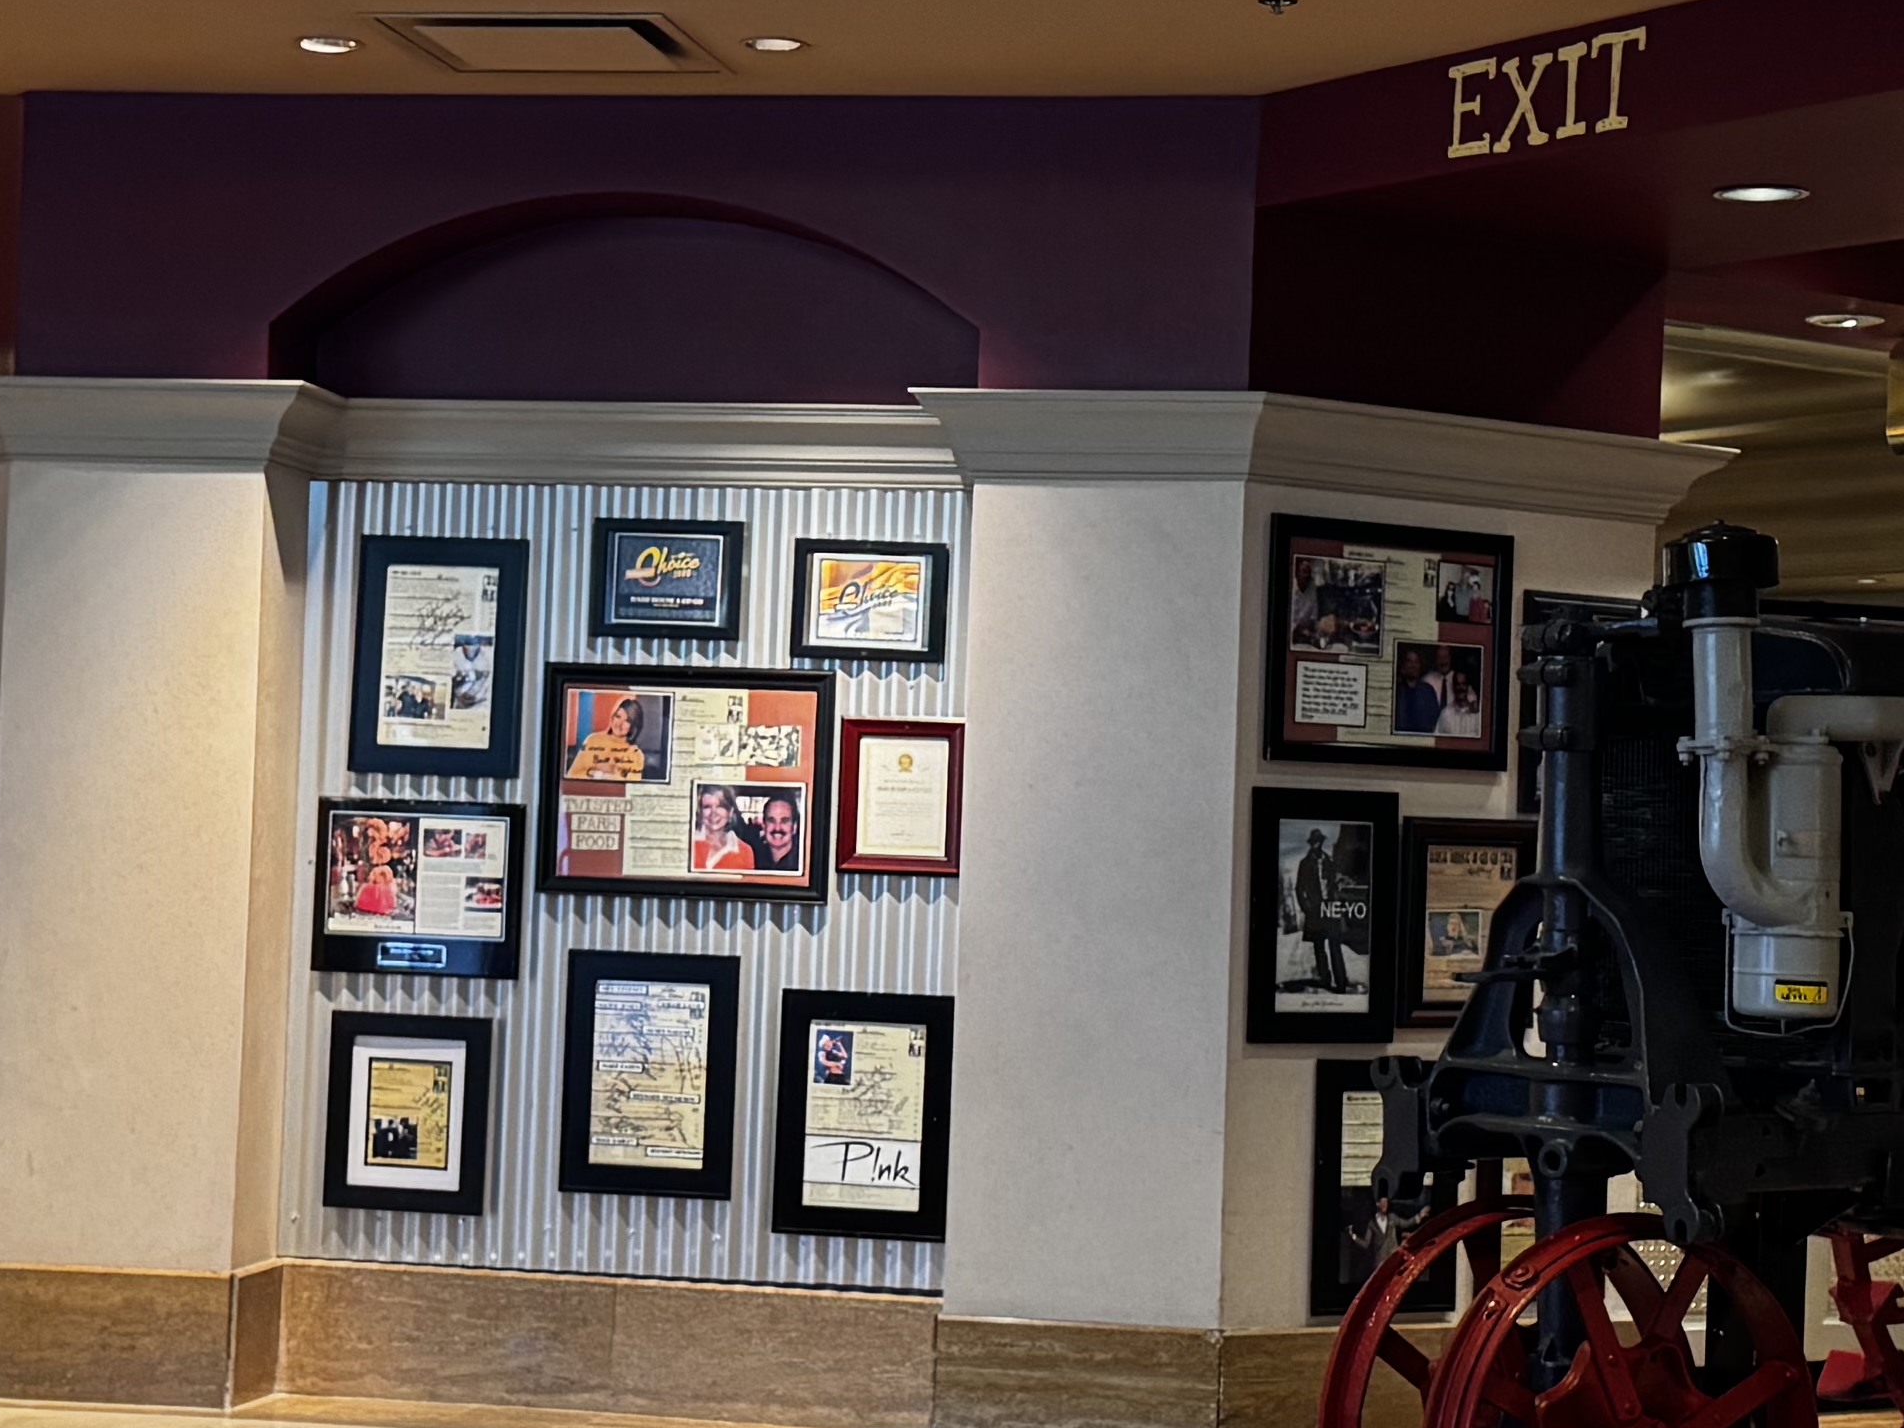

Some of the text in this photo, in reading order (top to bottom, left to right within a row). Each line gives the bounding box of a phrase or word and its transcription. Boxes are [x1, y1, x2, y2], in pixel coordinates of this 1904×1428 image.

[1447, 25, 1647, 159] EXIT
[1320, 901, 1367, 919] NE-YO
[810, 1141, 918, 1186] P!nk
